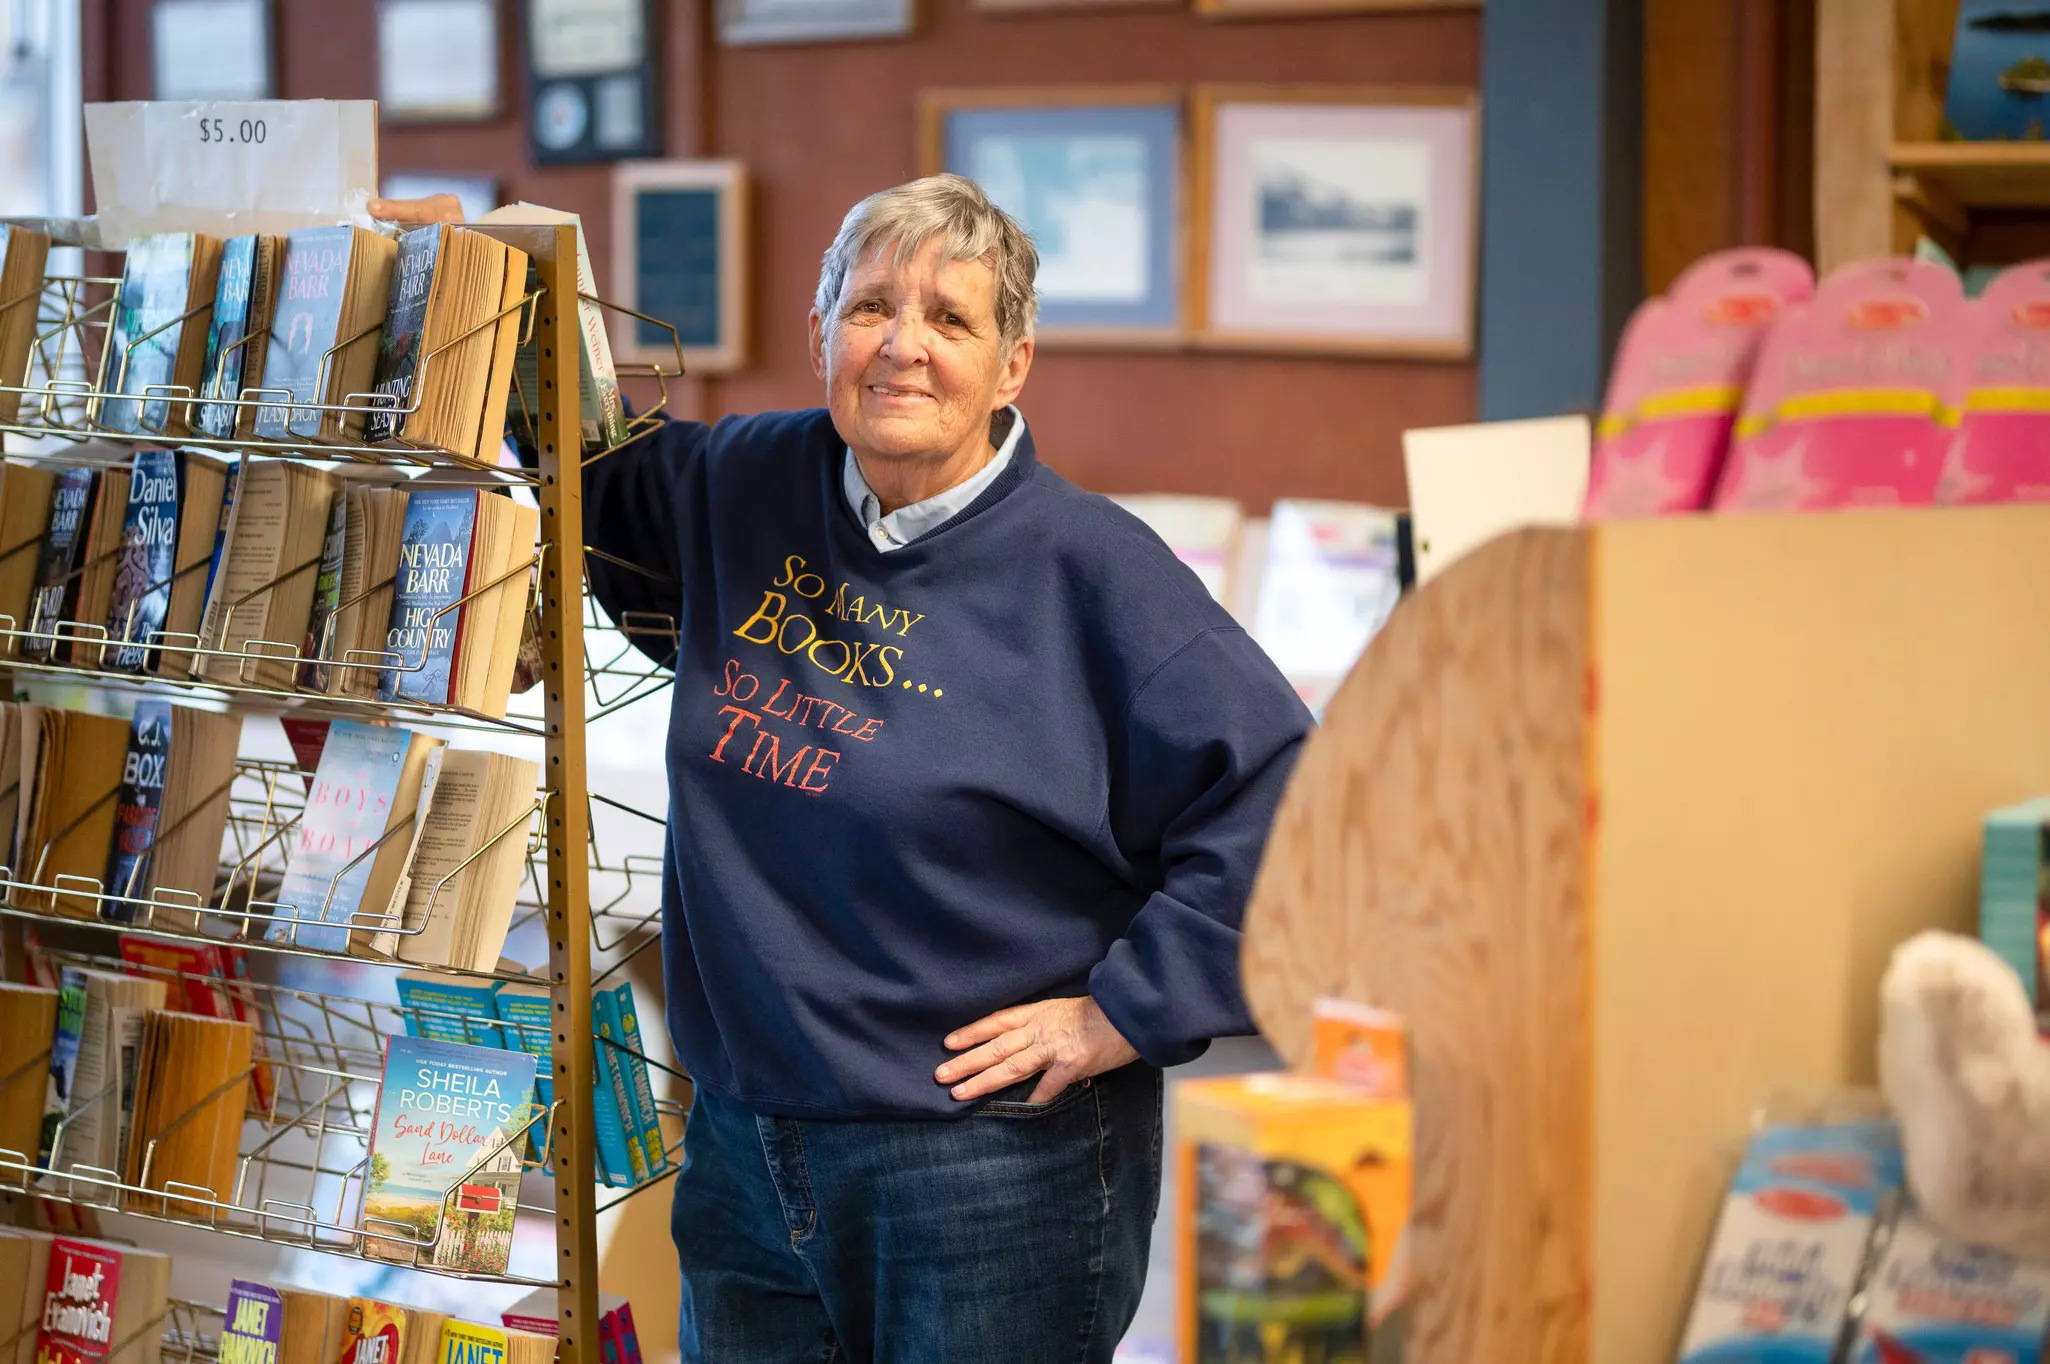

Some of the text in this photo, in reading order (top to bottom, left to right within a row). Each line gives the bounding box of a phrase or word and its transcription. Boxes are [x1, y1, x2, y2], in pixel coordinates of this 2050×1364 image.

[200, 118, 266, 143] $5.00
[284, 249, 342, 277] NEVADA
[399, 250, 434, 280] NEVADA
[288, 274, 329, 300] BARR
[400, 273, 425, 301] BARR
[588, 316, 604, 372] Weiner
[130, 469, 176, 504] Daniel
[52, 510, 78, 533] BARR
[135, 505, 175, 546] Silva
[400, 543, 463, 568] NEVADA
[406, 568, 449, 593] BARR
[774, 555, 925, 637] SO MANY
[405, 607, 442, 628] HIGH
[388, 628, 453, 649] COUNTRY
[733, 590, 943, 698] BOOKS...
[714, 659, 884, 742] SO LITTLE
[138, 719, 161, 748] C.J.
[709, 705, 841, 792] TIME
[123, 751, 166, 788] BOX
[314, 781, 390, 816] BOYS
[415, 1058, 508, 1077] USA TODAY BESTSELLING AUTHOR
[416, 1069, 501, 1099] SHEILA
[400, 1089, 512, 1123] ROBERTS
[394, 1113, 487, 1147] Sand Dollar
[420, 1141, 455, 1167] Lane
[232, 1296, 270, 1337] JANET
[353, 1334, 390, 1364] JANET
